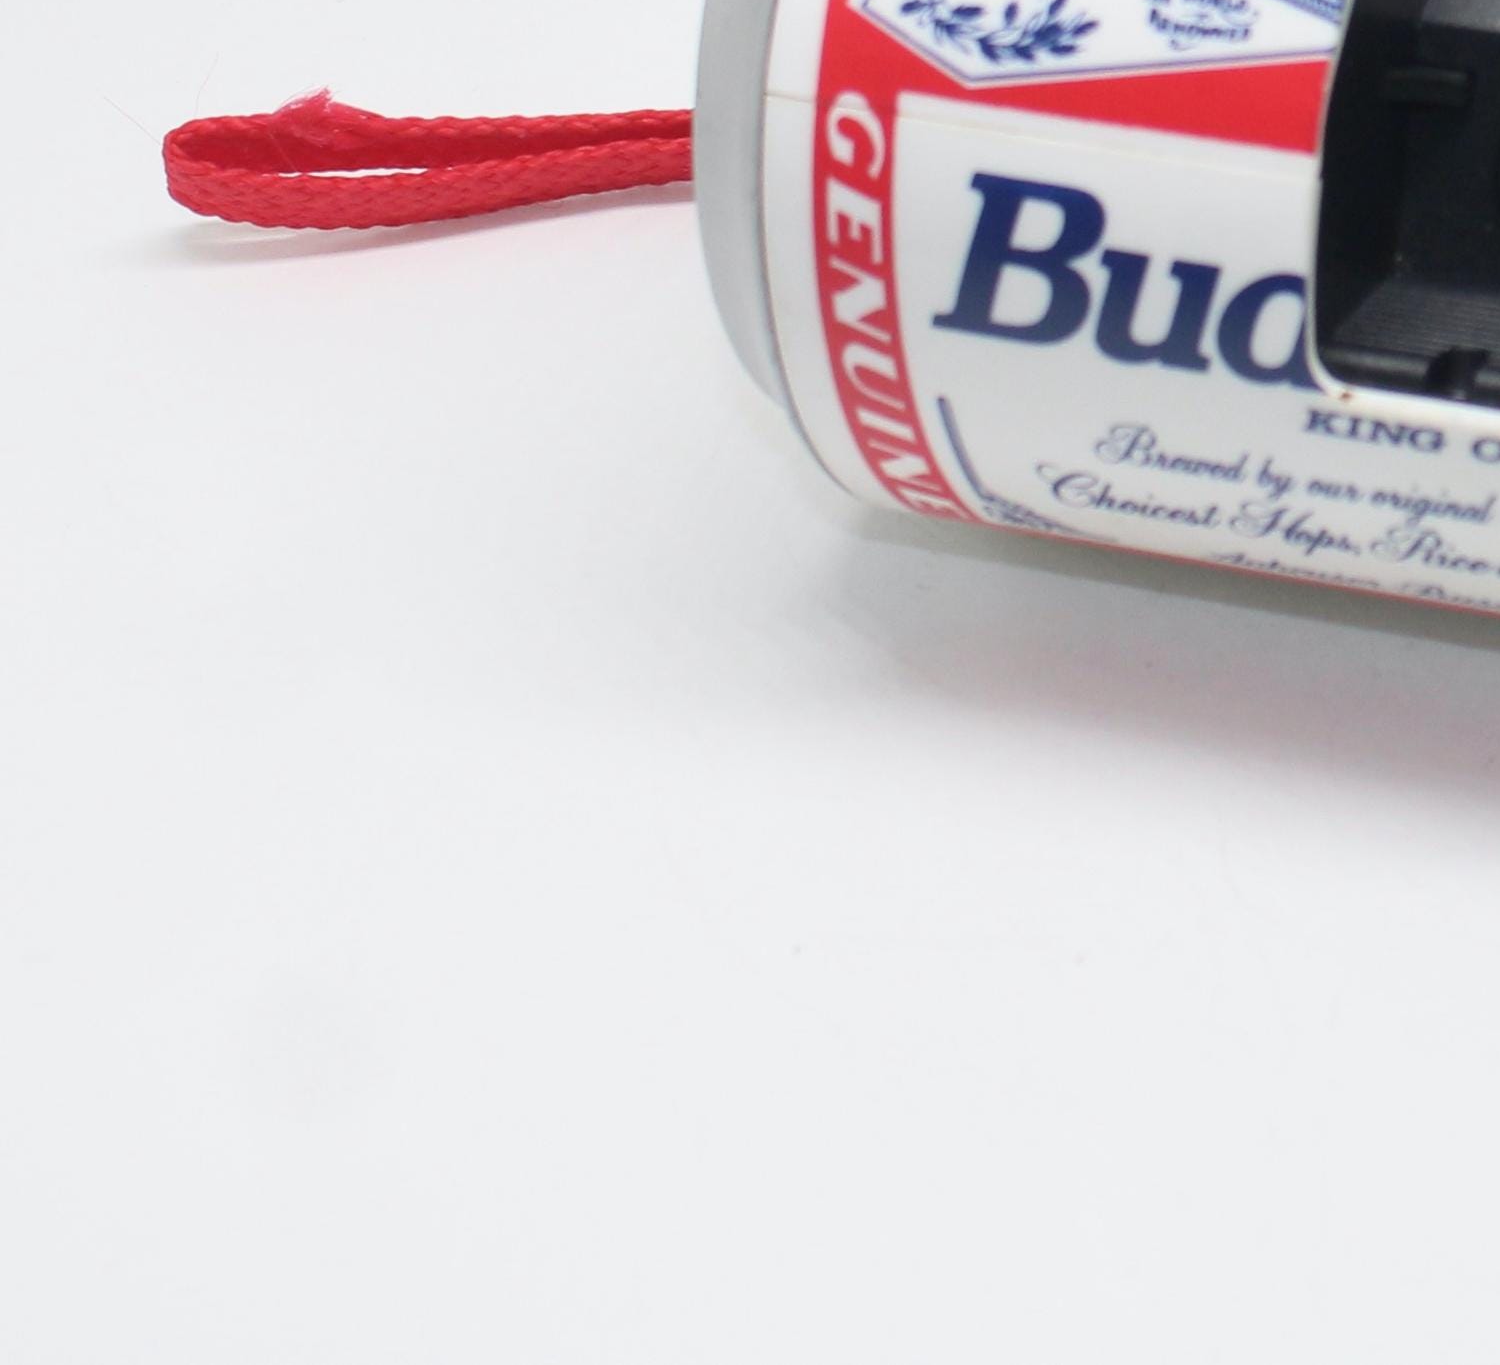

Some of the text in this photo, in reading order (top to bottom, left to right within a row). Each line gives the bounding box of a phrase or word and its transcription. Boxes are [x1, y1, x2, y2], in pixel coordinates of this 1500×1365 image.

[825, 90, 968, 519] GENUINE
[1094, 422, 1249, 484] Brewed
[1256, 457, 1293, 501] by
[1305, 477, 1361, 505] our
[1369, 486, 1497, 524] original
[1304, 408, 1447, 455] KING
[1036, 460, 1222, 529] Choicest
[1370, 521, 1489, 573] Rice
